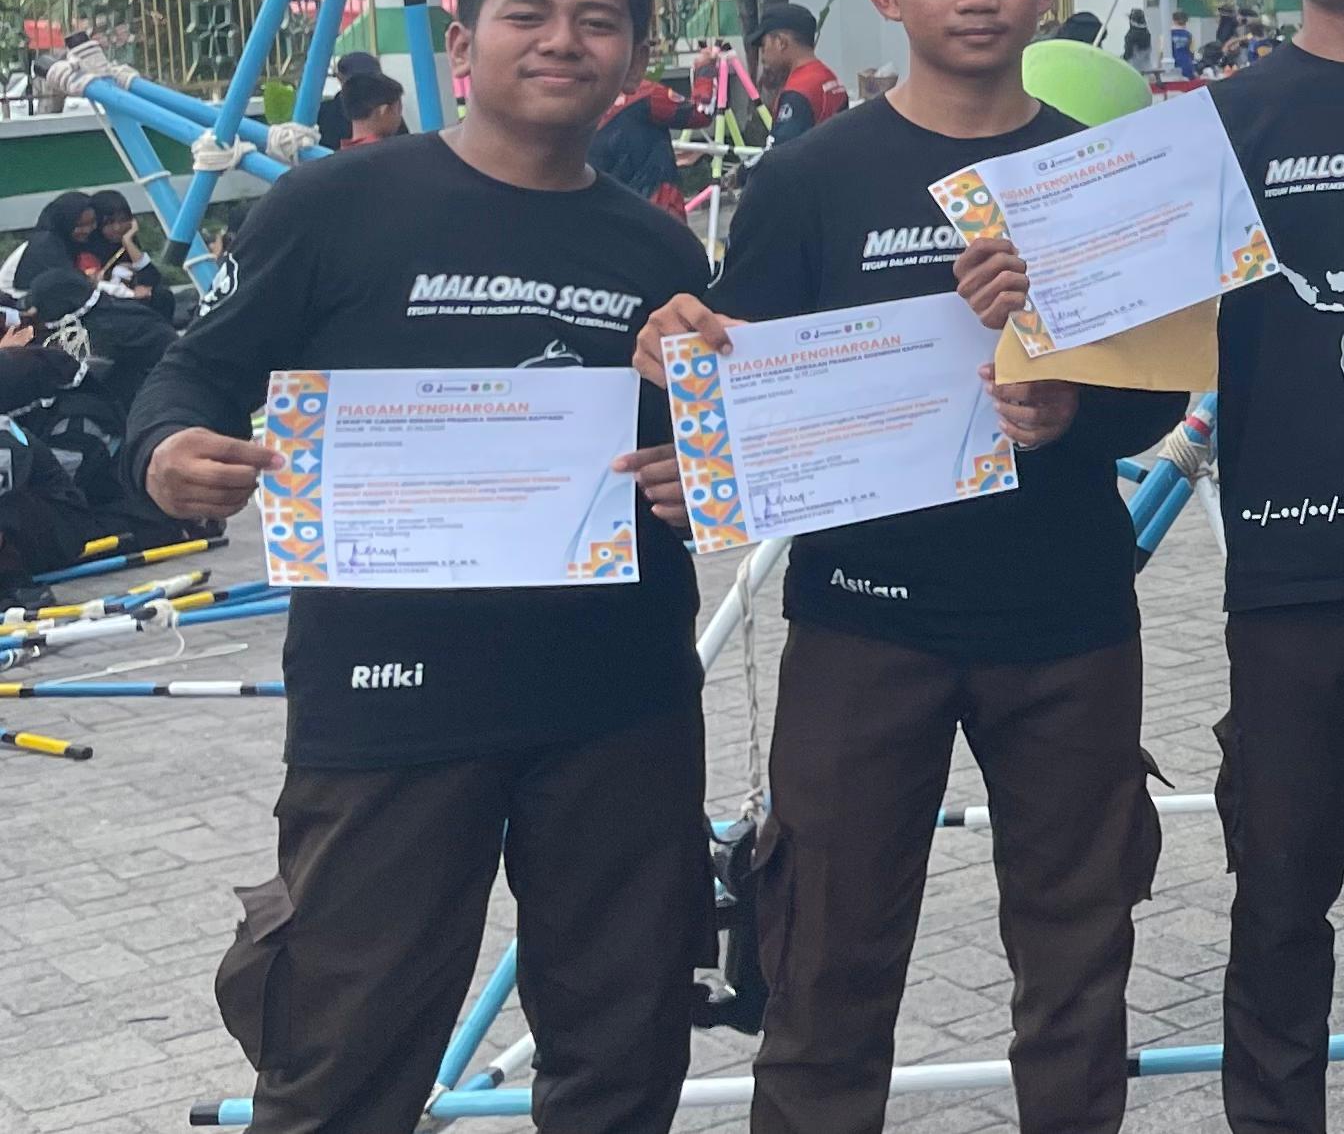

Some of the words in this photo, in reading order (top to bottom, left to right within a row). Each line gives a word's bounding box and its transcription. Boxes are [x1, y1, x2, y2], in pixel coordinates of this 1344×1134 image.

[1036, 151, 1137, 193] PENGHARGAAN
[409, 274, 556, 305] MALLOMO
[556, 285, 643, 319] SCOUT
[729, 354, 787, 375] PIAGAM
[792, 335, 902, 364] PENGHARGAAN
[338, 404, 403, 416] PIAGAM
[407, 402, 529, 415] PENGHARGAAN
[351, 662, 424, 689] Rifki
